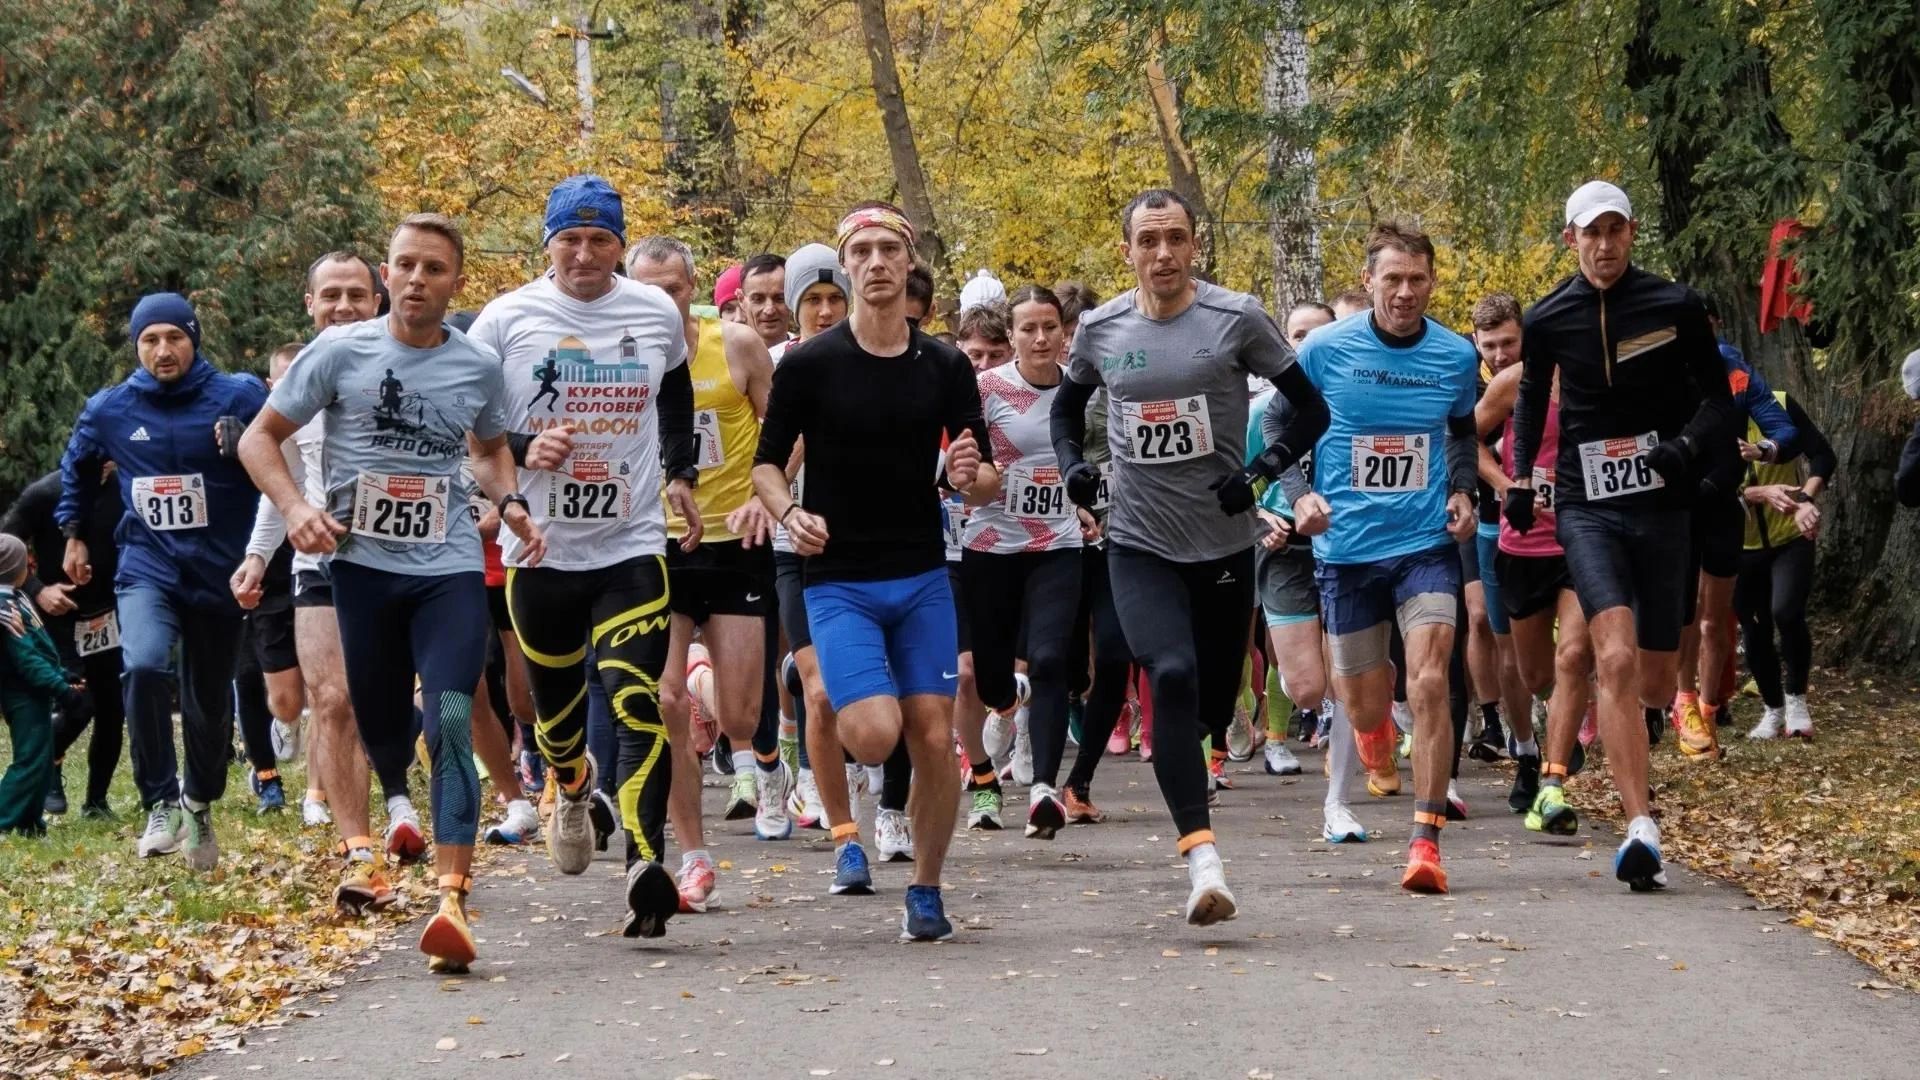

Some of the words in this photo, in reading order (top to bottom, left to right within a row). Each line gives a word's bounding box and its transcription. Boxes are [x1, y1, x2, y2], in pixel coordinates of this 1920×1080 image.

[565, 400, 645, 413] СОЛОВЕЙ
[568, 385, 649, 399] КУРСКИЙ
[1137, 421, 1194, 458] 223
[1365, 455, 1414, 488] 207
[1601, 455, 1653, 493] 326
[148, 495, 194, 526] 313
[563, 483, 618, 519] 322
[1022, 485, 1064, 515] 394
[373, 498, 432, 538] 253
[83, 626, 109, 652] 228
